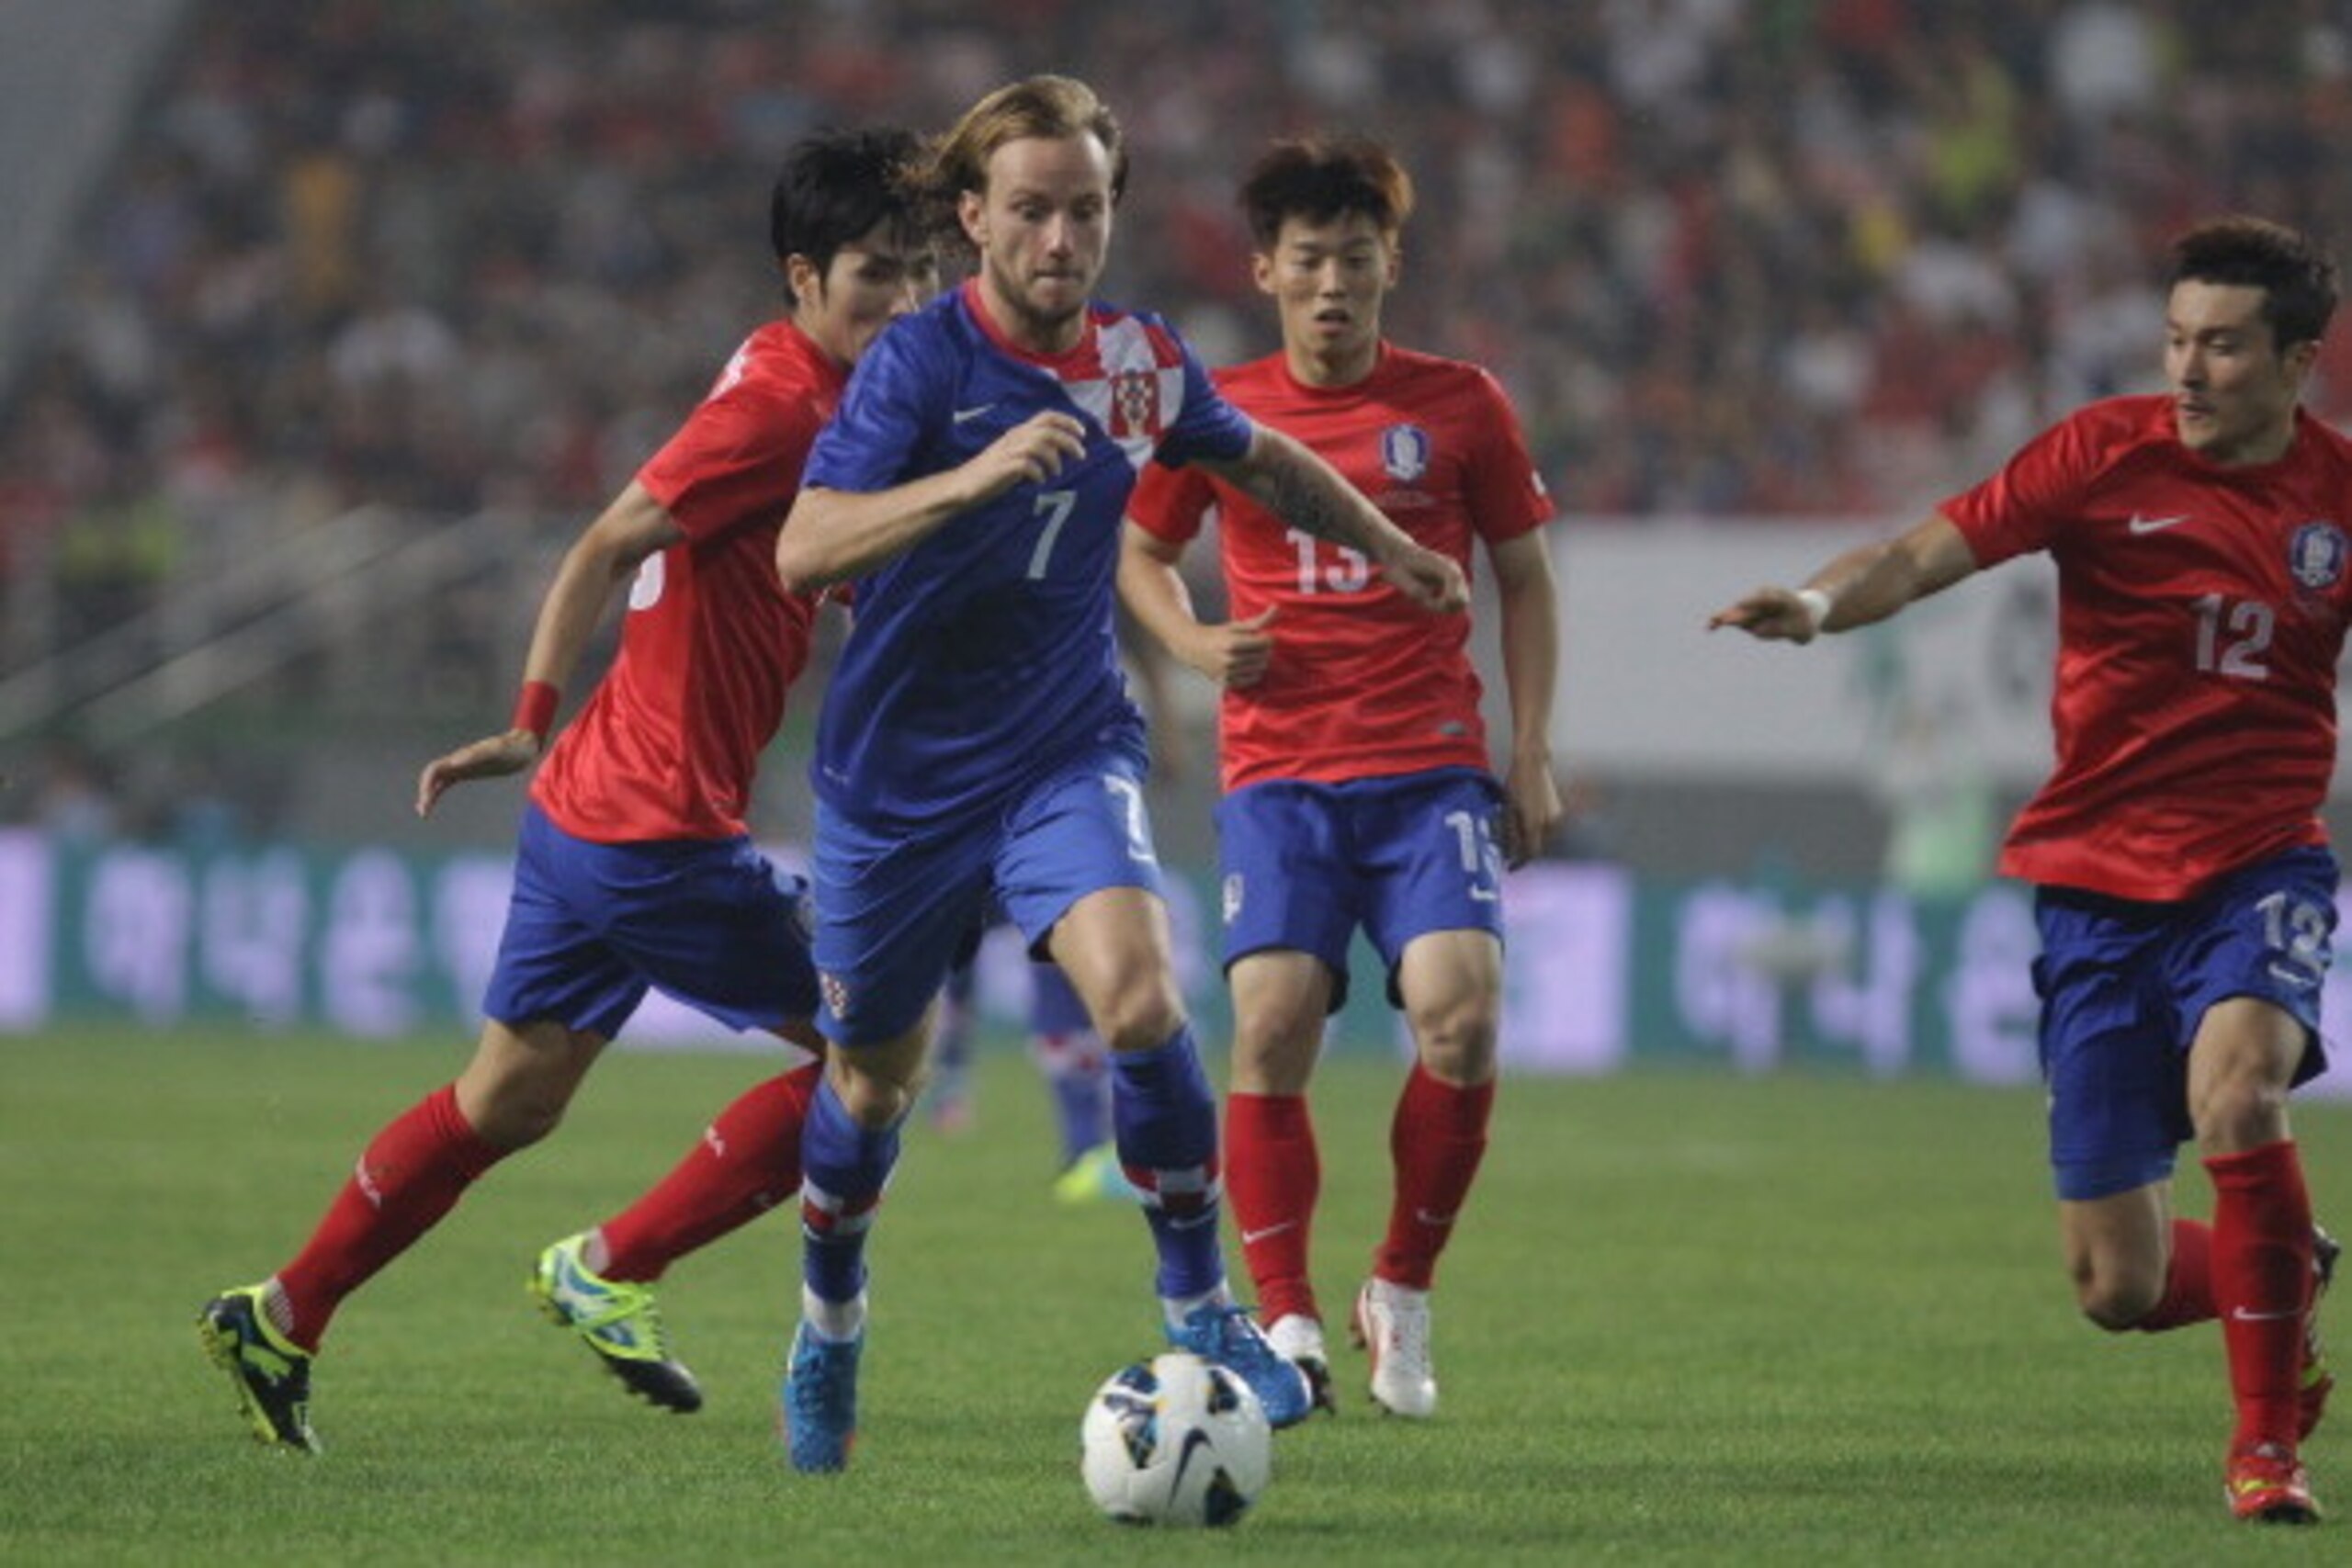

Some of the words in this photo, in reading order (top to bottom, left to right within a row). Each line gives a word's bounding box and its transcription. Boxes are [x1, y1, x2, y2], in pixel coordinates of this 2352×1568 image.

[1026, 489, 1079, 580] 7
[2190, 592, 2275, 681] 12
[2254, 890, 2326, 973] 12
